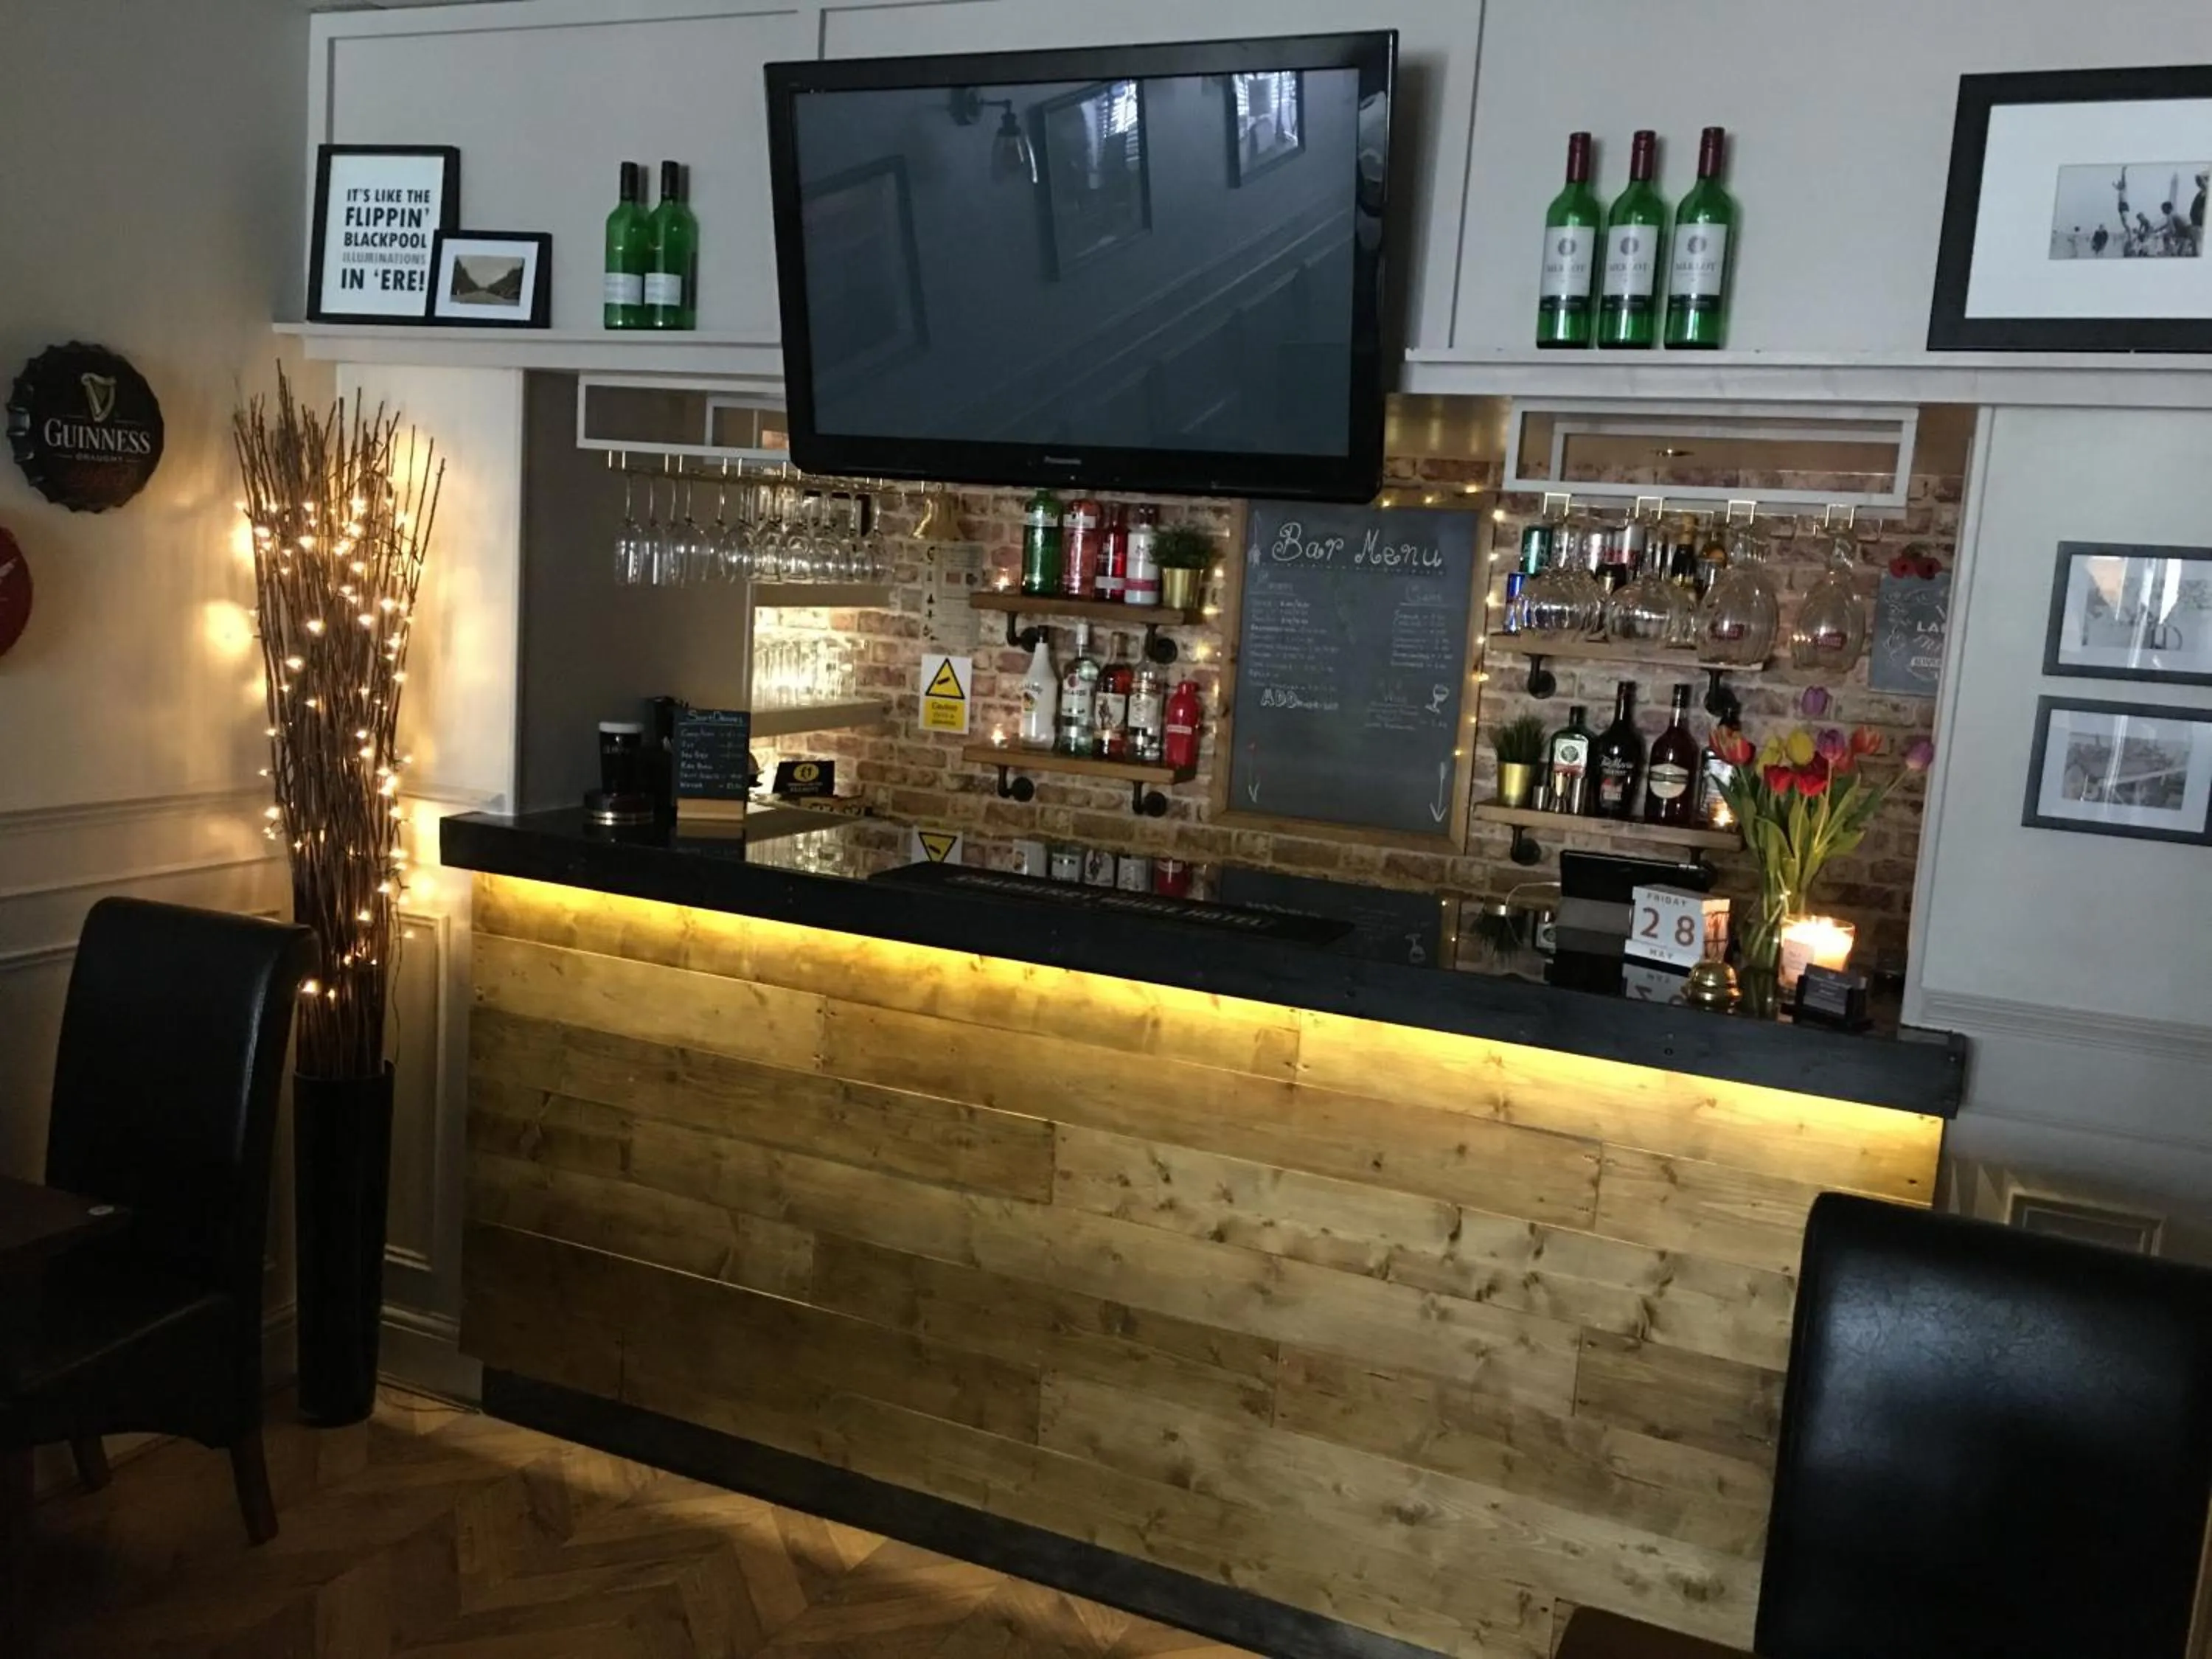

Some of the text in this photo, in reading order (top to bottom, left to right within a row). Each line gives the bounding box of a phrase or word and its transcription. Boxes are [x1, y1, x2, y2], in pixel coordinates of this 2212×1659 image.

[347, 189, 431, 203] IT'S LIKE THE
[345, 206, 430, 228] FLIPPIN'
[344, 232, 427, 248] BLACKPOOL
[342, 251, 425, 265] ILLUMINATIONS
[1547, 264, 1586, 272] MEROT
[1609, 262, 1647, 272] MEROT
[341, 268, 425, 291] IN 'ERE!
[44, 418, 151, 454] GUINNESS
[1271, 521, 1443, 568] Bar Menu
[1647, 892, 1688, 907] FRIDAY
[1649, 948, 1674, 960] MAY
